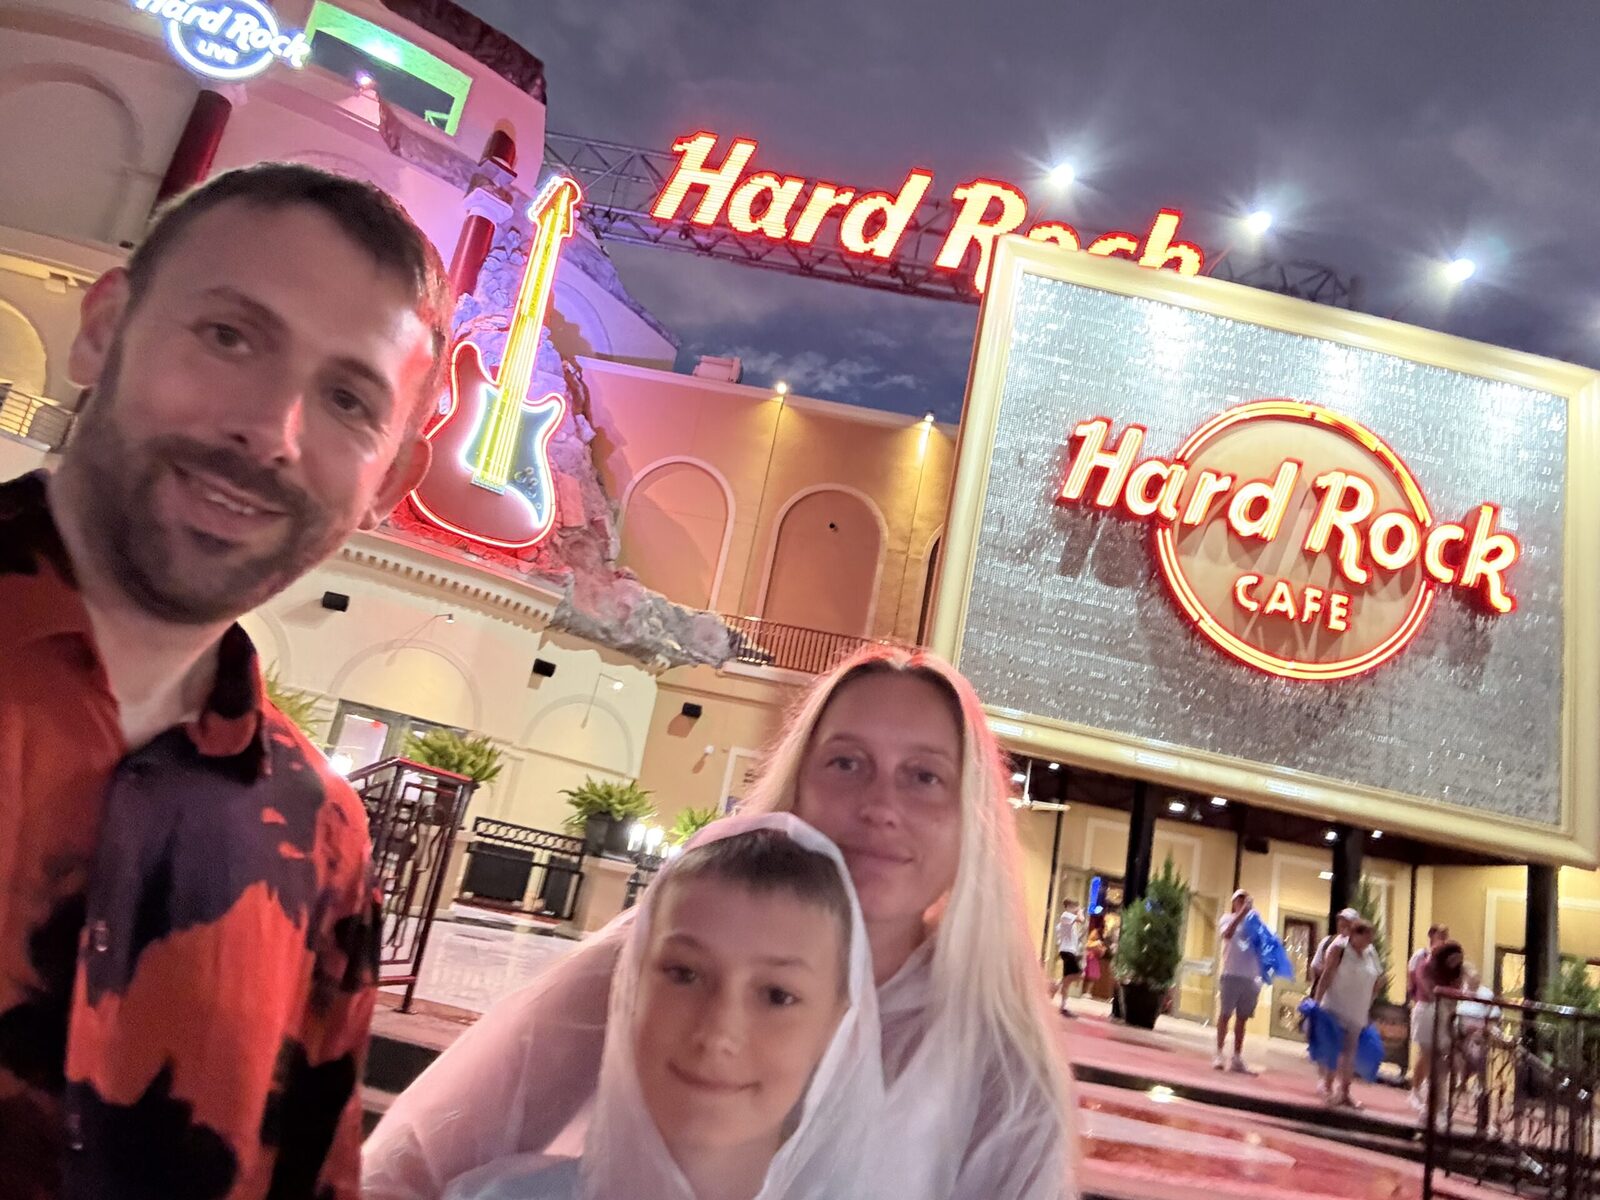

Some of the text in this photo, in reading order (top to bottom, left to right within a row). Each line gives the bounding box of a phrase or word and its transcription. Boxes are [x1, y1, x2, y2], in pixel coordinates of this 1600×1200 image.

[197, 39, 239, 65] LIVE
[225, 12, 311, 69] Rock
[650, 131, 935, 260] Hard
[1059, 417, 1522, 615] Hard Rock
[1234, 573, 1353, 635] CAFE
